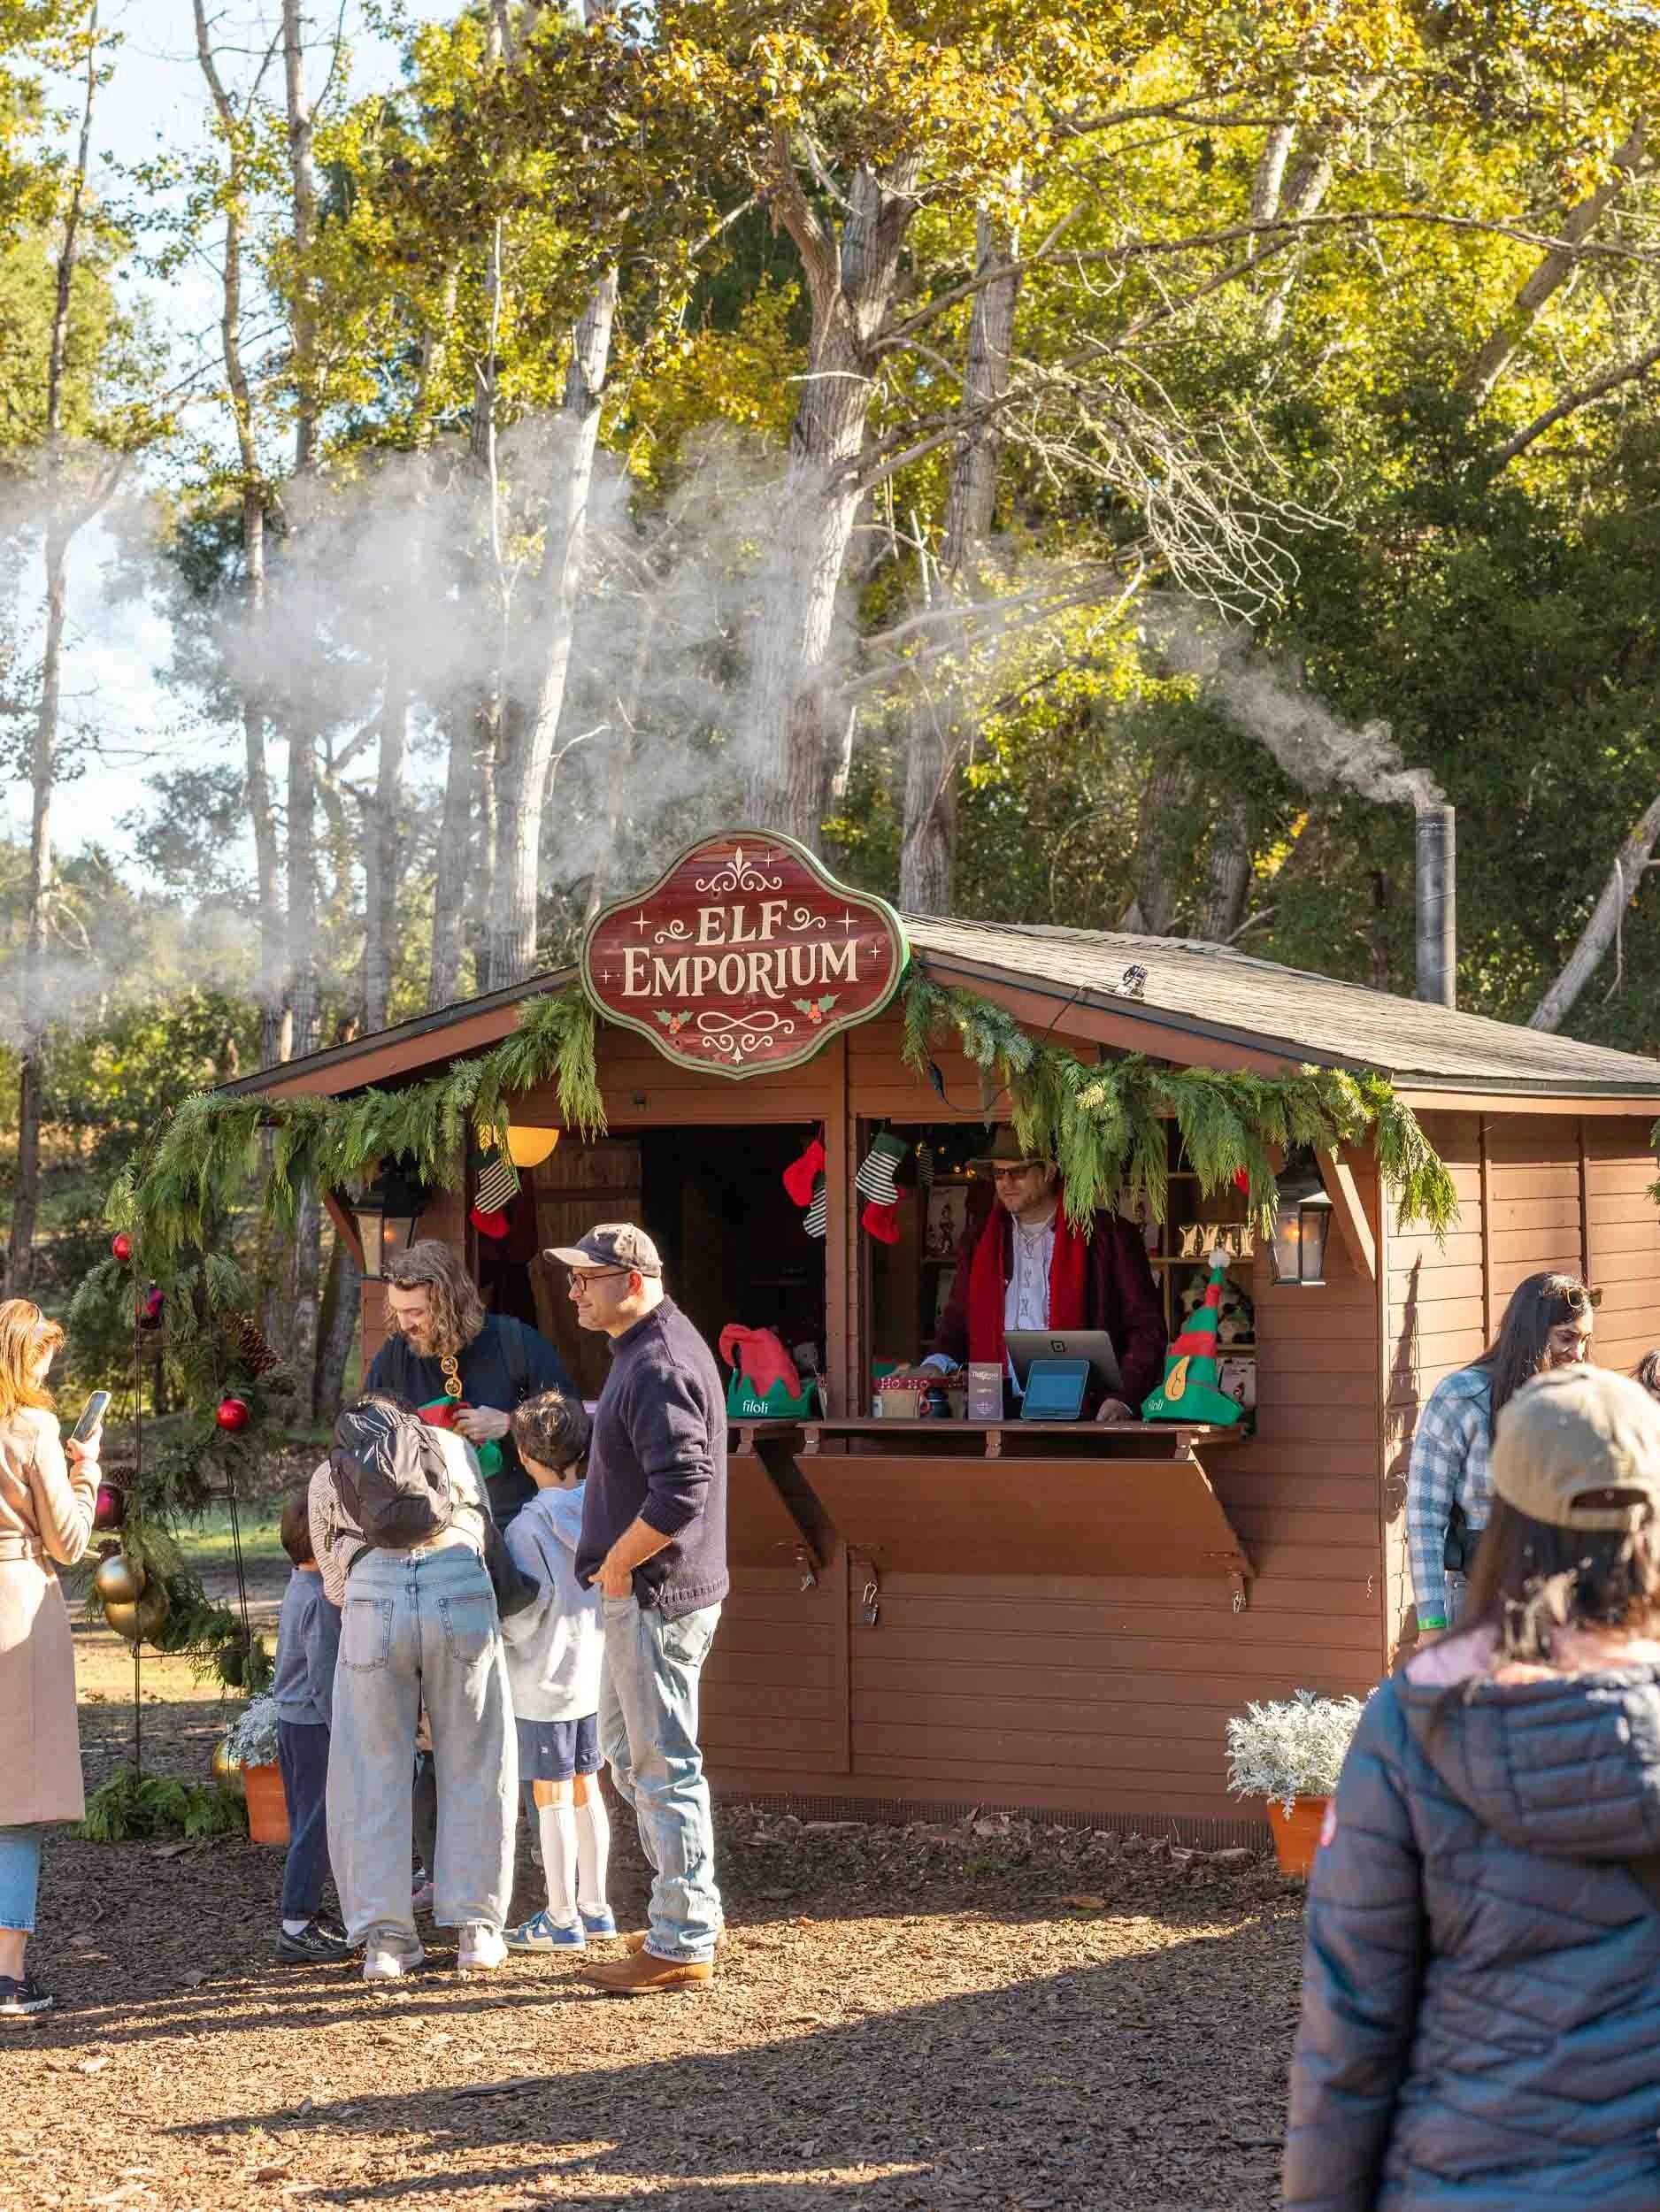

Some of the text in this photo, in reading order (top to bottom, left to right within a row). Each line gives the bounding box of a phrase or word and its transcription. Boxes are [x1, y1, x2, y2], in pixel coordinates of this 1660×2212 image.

[695, 899, 788, 946] ELF
[621, 939, 860, 999] EMPORIUM
[743, 1399, 768, 1415] filoli
